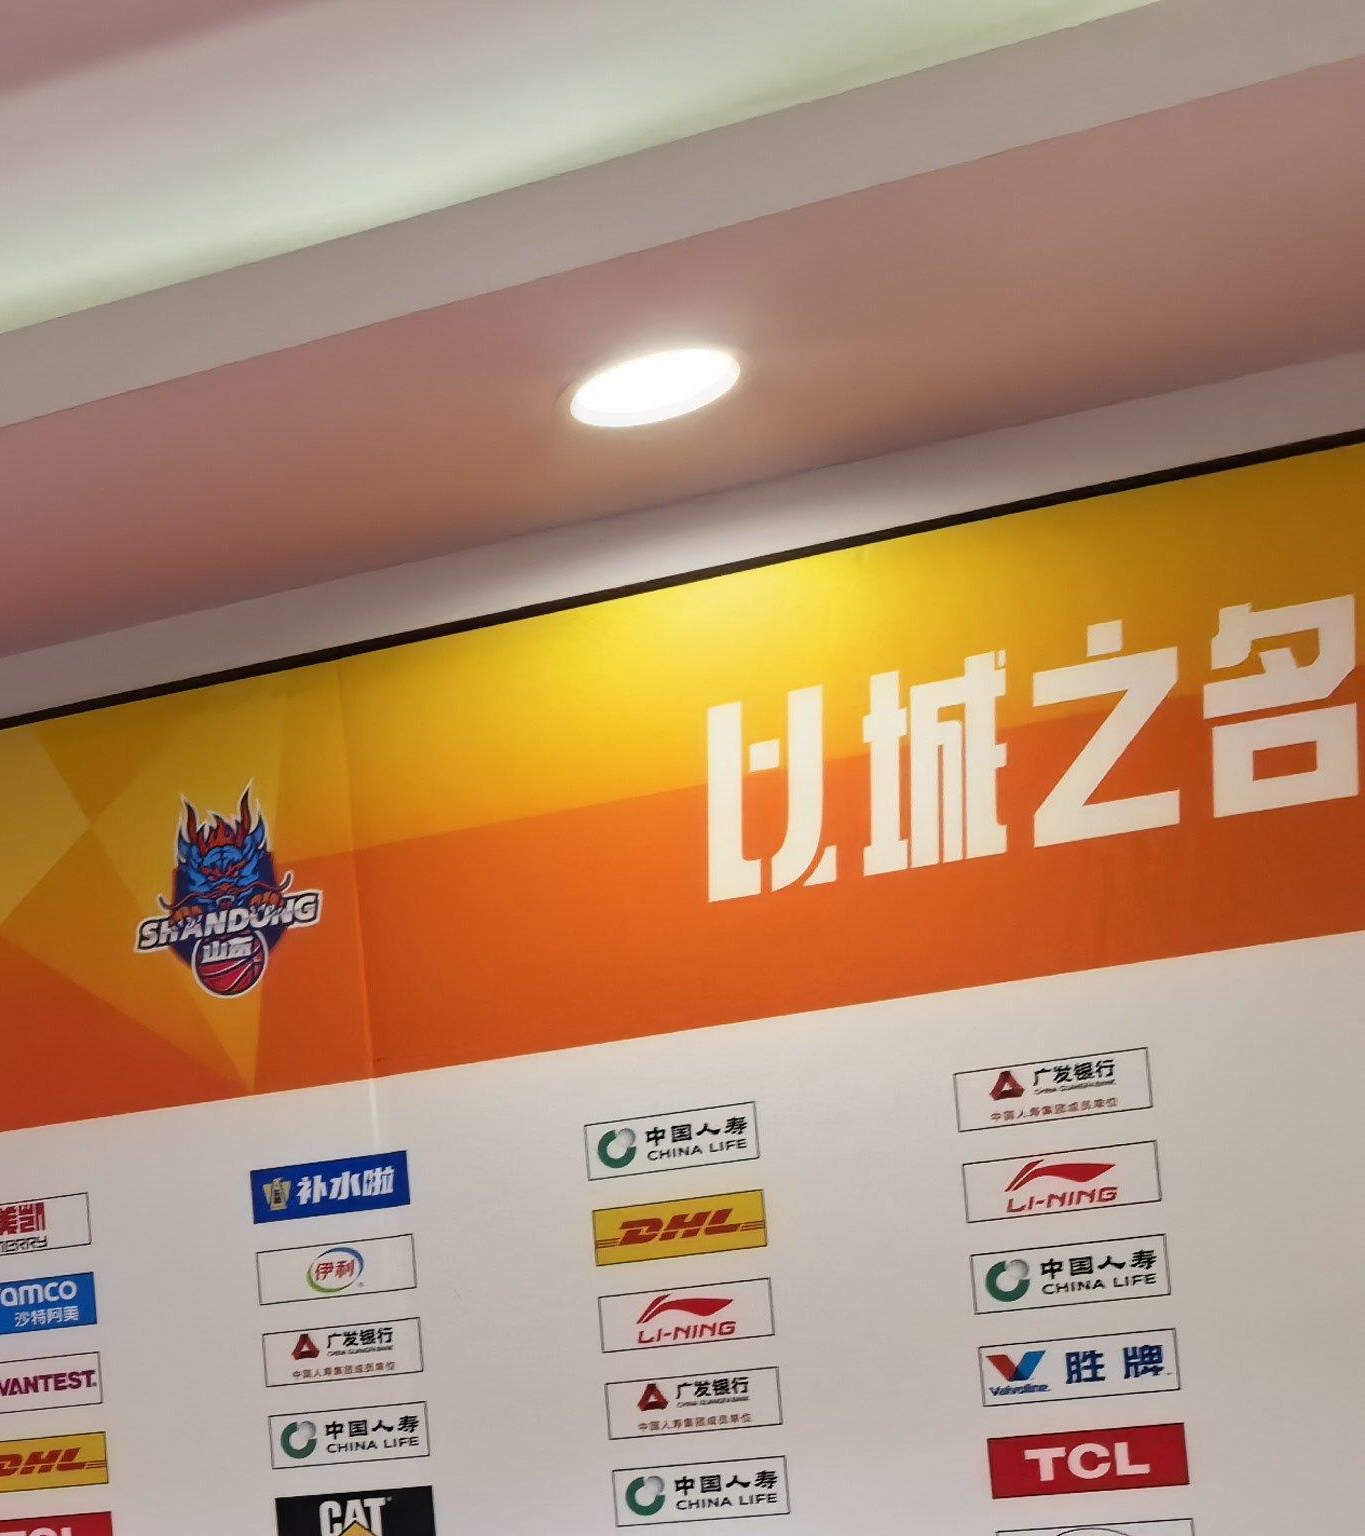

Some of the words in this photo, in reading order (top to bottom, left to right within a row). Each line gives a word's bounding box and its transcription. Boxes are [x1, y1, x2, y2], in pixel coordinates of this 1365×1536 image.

[707, 594, 1359, 903] 以城之名
[139, 894, 317, 949] SHANDONG
[1033, 1060, 1115, 1086] 广发银行
[645, 1117, 747, 1146] 中国人寿
[647, 1146, 702, 1160] CHINA
[709, 1139, 747, 1152] LIFE
[296, 1166, 394, 1205] 补水啦
[1007, 1187, 1118, 1212] LI-NING
[617, 1208, 741, 1246] DHL
[314, 1260, 354, 1282] 伊利
[1040, 1250, 1157, 1279] 中国人寿
[1042, 1279, 1105, 1294] CHINA
[1113, 1273, 1156, 1287] LIFE
[15, 1306, 79, 1327] 沙特阿美
[327, 1328, 393, 1348] 广发银行
[638, 1321, 736, 1344] LI-NING
[1065, 1345, 1164, 1384] 胜牌
[676, 1377, 748, 1399] 广发银行
[325, 1416, 419, 1440] 中国人寿
[327, 1441, 377, 1453] CHINA
[384, 1436, 419, 1448] LIFE
[1024, 1442, 1150, 1481] TCL
[675, 1470, 777, 1496] 中国人寿
[676, 1497, 732, 1510] CHINA
[739, 1493, 777, 1505] LIFE
